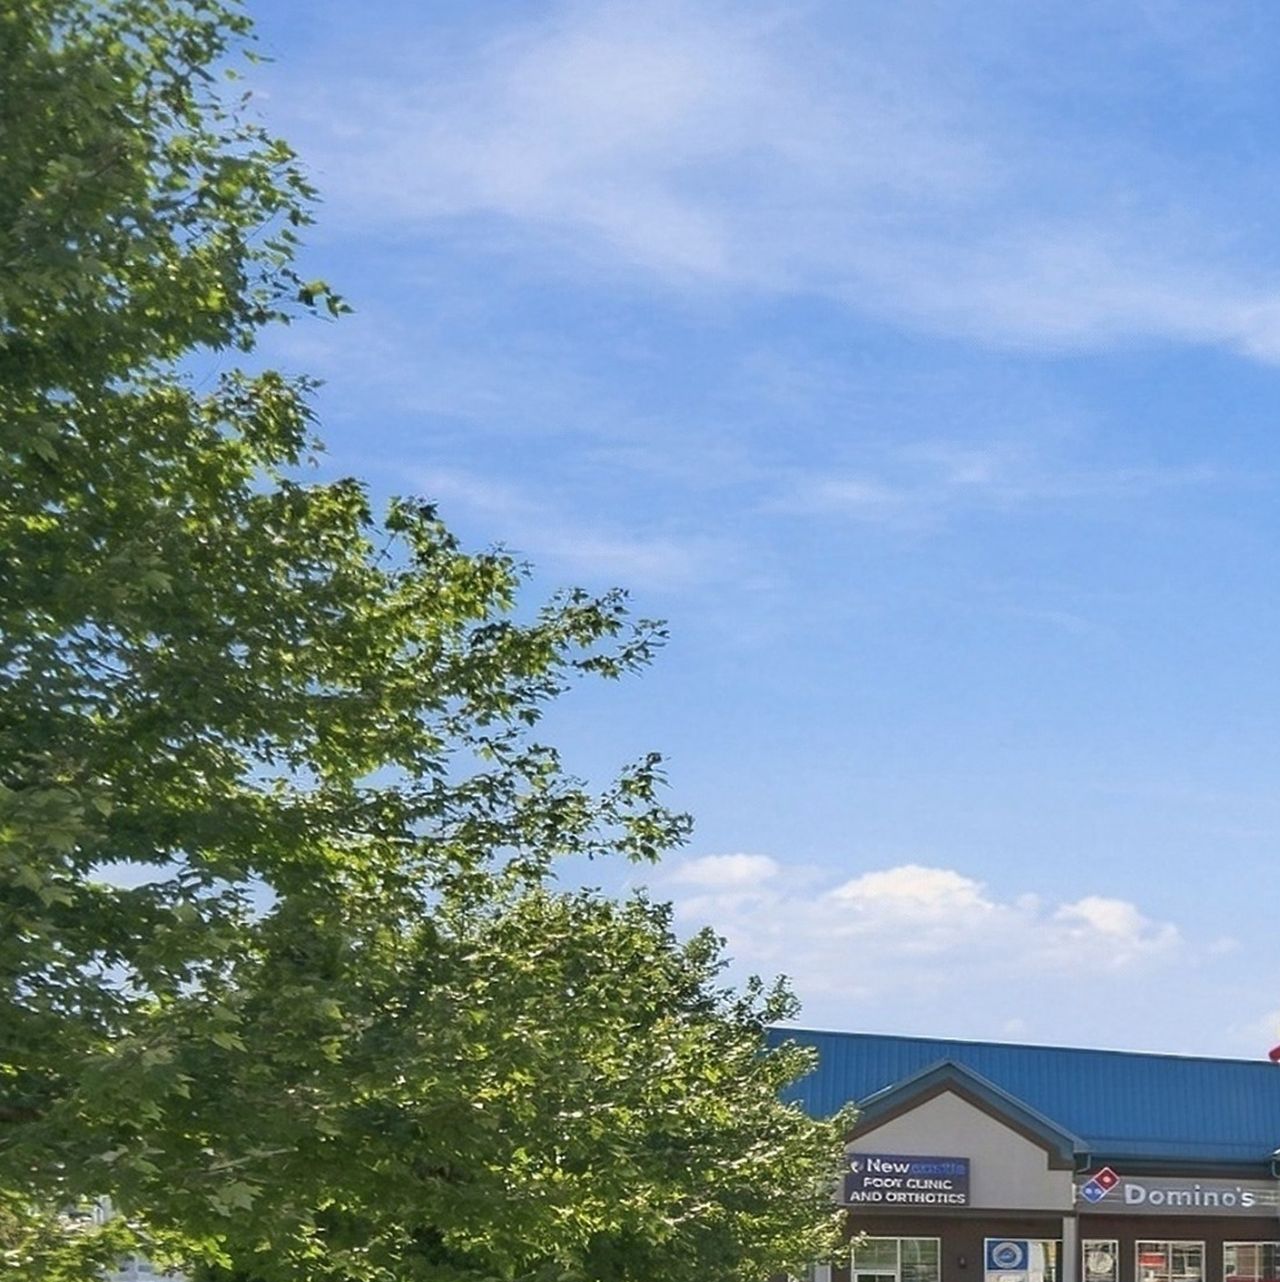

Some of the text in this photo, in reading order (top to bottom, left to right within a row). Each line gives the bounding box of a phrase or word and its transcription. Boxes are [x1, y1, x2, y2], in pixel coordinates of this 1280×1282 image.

[863, 1177, 953, 1190] FOOT CLINIC
[850, 1191, 966, 1205] AND ORTHOTICS
[1124, 1184, 1256, 1208] Domino's
